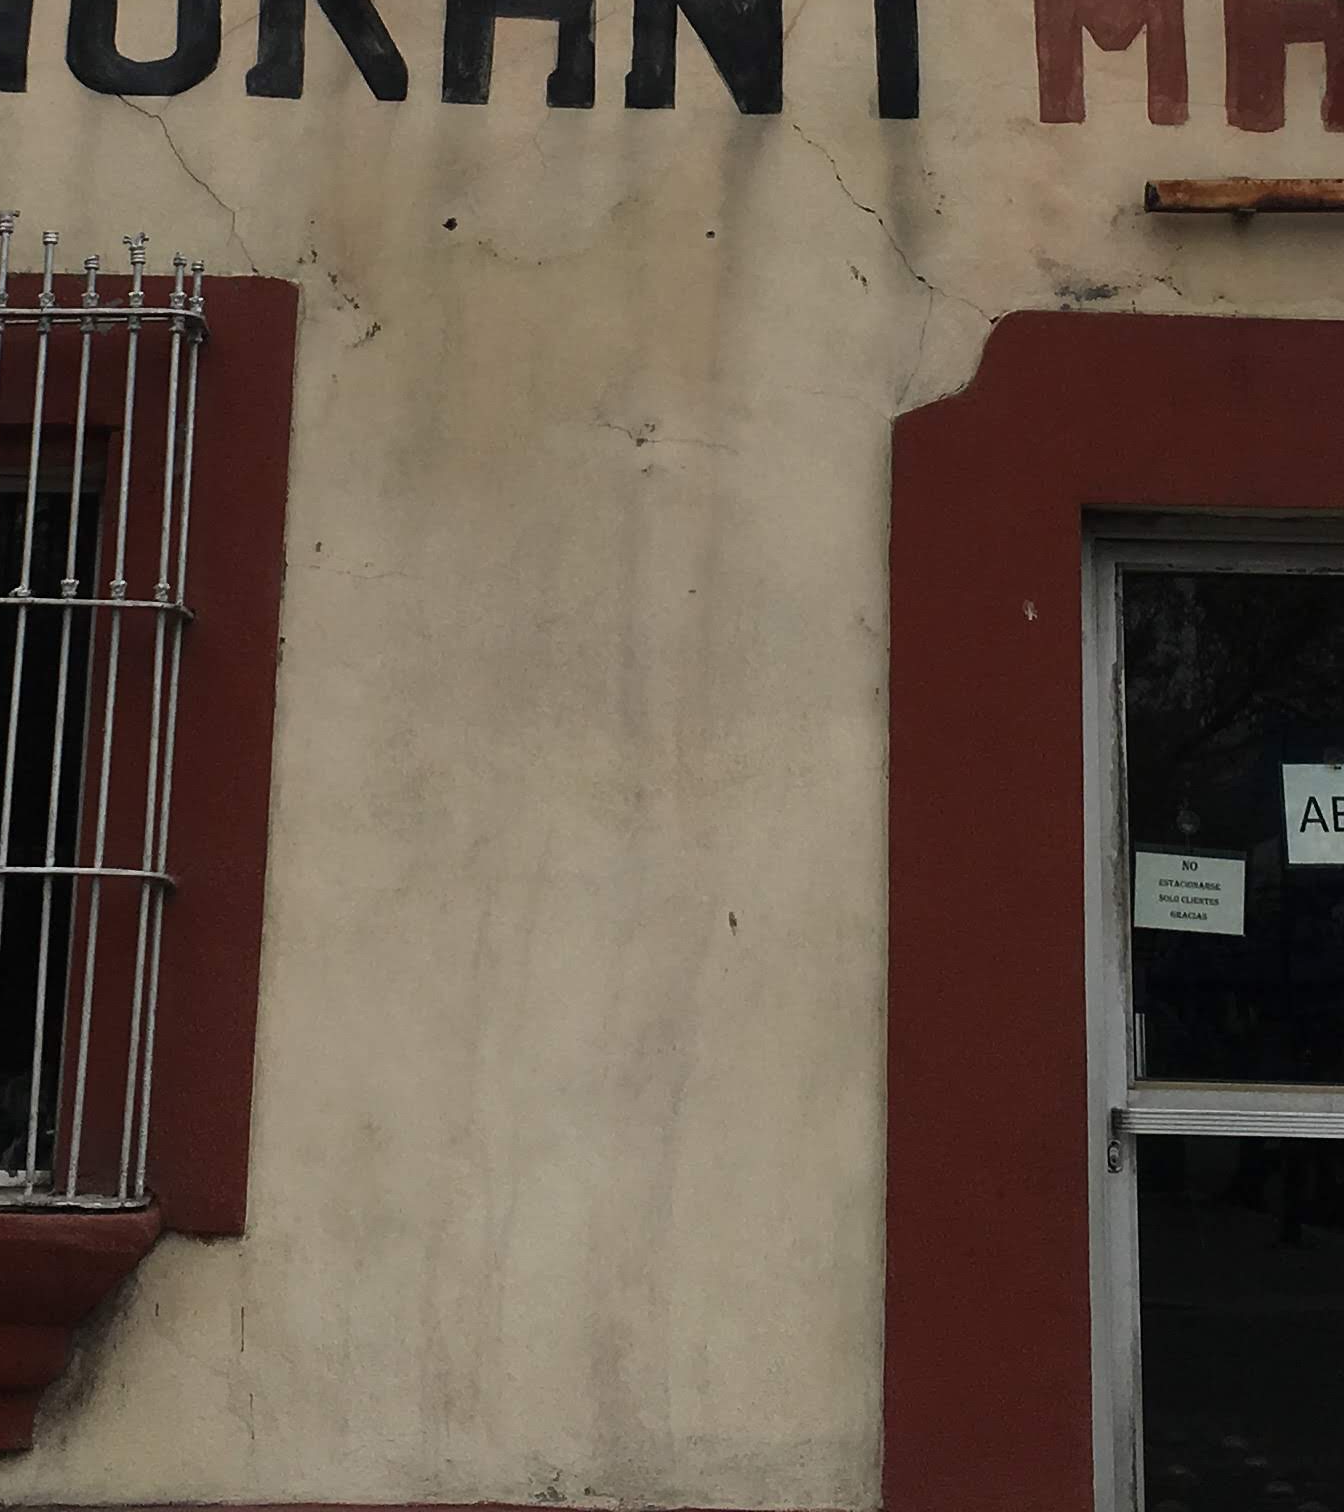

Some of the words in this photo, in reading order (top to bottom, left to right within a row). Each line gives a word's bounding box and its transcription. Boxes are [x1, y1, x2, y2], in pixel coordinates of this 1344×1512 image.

[1181, 859, 1199, 872] NO
[1158, 893, 1180, 904] SOLO
[1181, 895, 1220, 906] CLIENTES
[1169, 909, 1208, 921] GRACIAS
